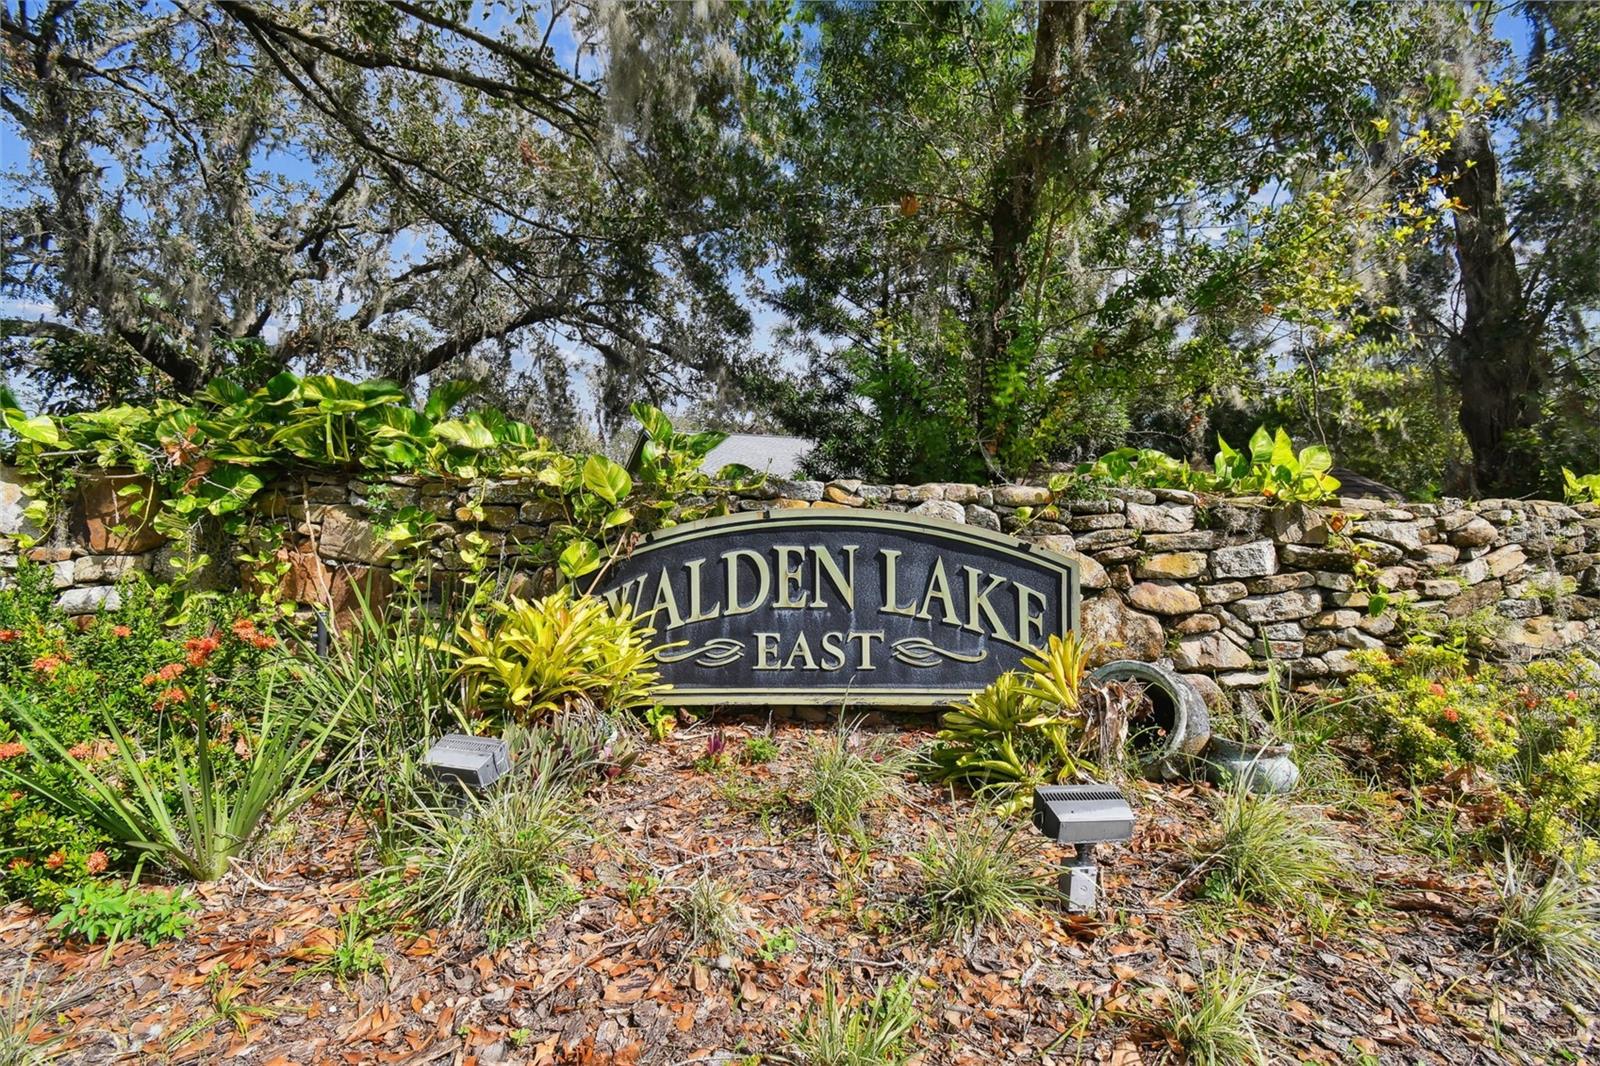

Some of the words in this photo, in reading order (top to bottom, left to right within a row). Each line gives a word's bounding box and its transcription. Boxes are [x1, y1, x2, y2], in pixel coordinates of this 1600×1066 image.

[603, 544, 859, 638] WALDEN
[880, 550, 1047, 651] LAKE
[753, 630, 884, 670] EAST
